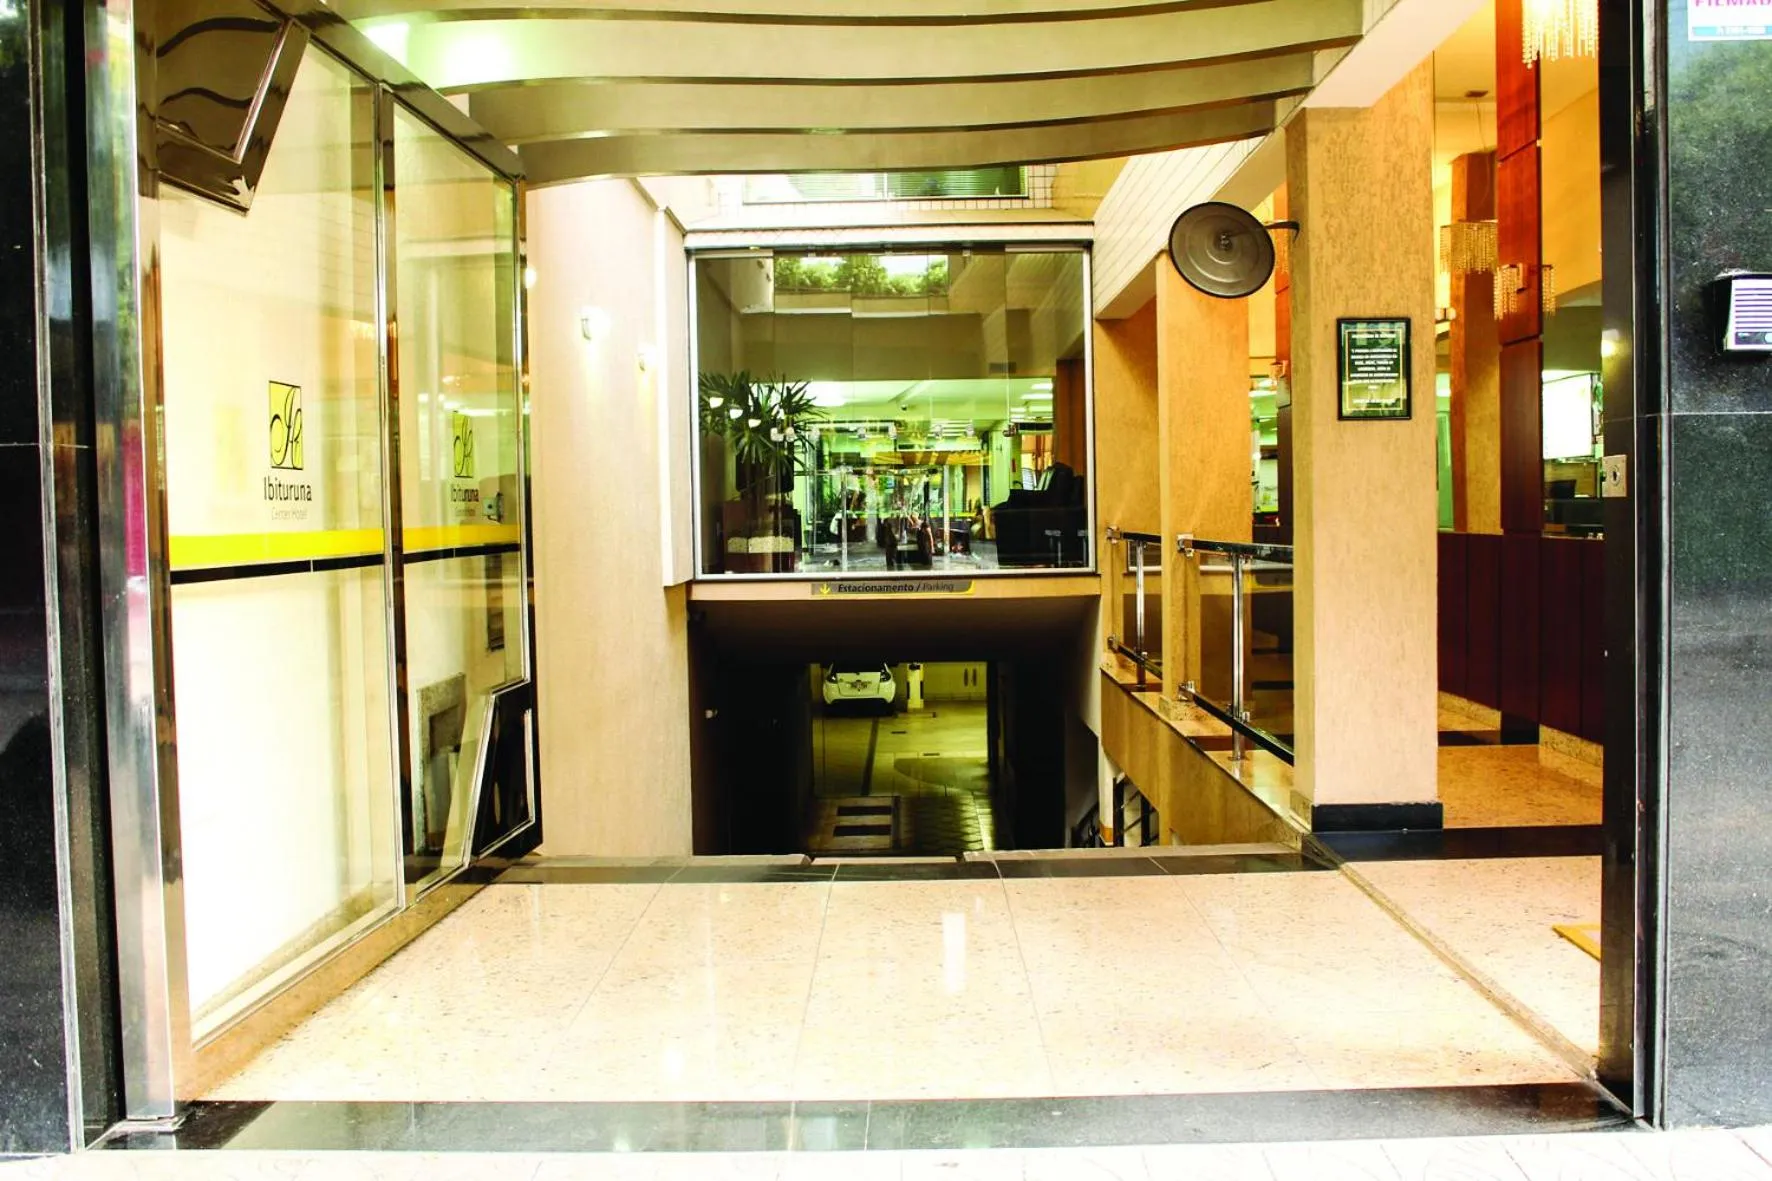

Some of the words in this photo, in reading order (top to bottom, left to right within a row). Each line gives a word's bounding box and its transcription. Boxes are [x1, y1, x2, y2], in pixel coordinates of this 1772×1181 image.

[263, 475, 312, 501] Ibituruna
[838, 583, 914, 593] Estacionamento
[923, 582, 954, 593] Parking
